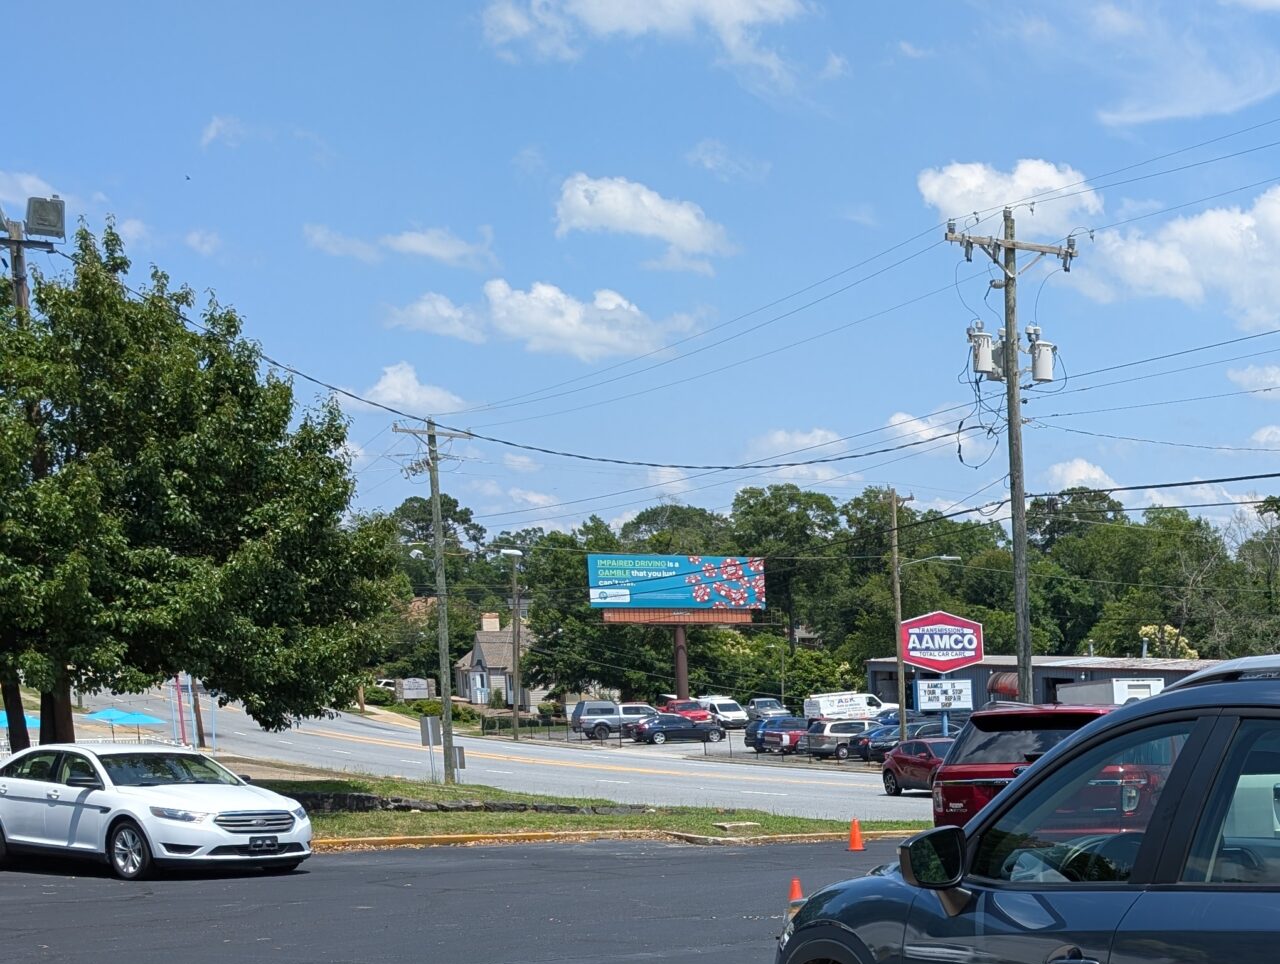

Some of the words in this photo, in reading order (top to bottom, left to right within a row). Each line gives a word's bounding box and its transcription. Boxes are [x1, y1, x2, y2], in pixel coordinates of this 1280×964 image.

[597, 560, 634, 568] IMPAIRED
[635, 560, 667, 568] DRIVING
[598, 569, 630, 577] GAMBLE
[662, 570, 676, 578] just
[907, 634, 978, 650] AAMCO
